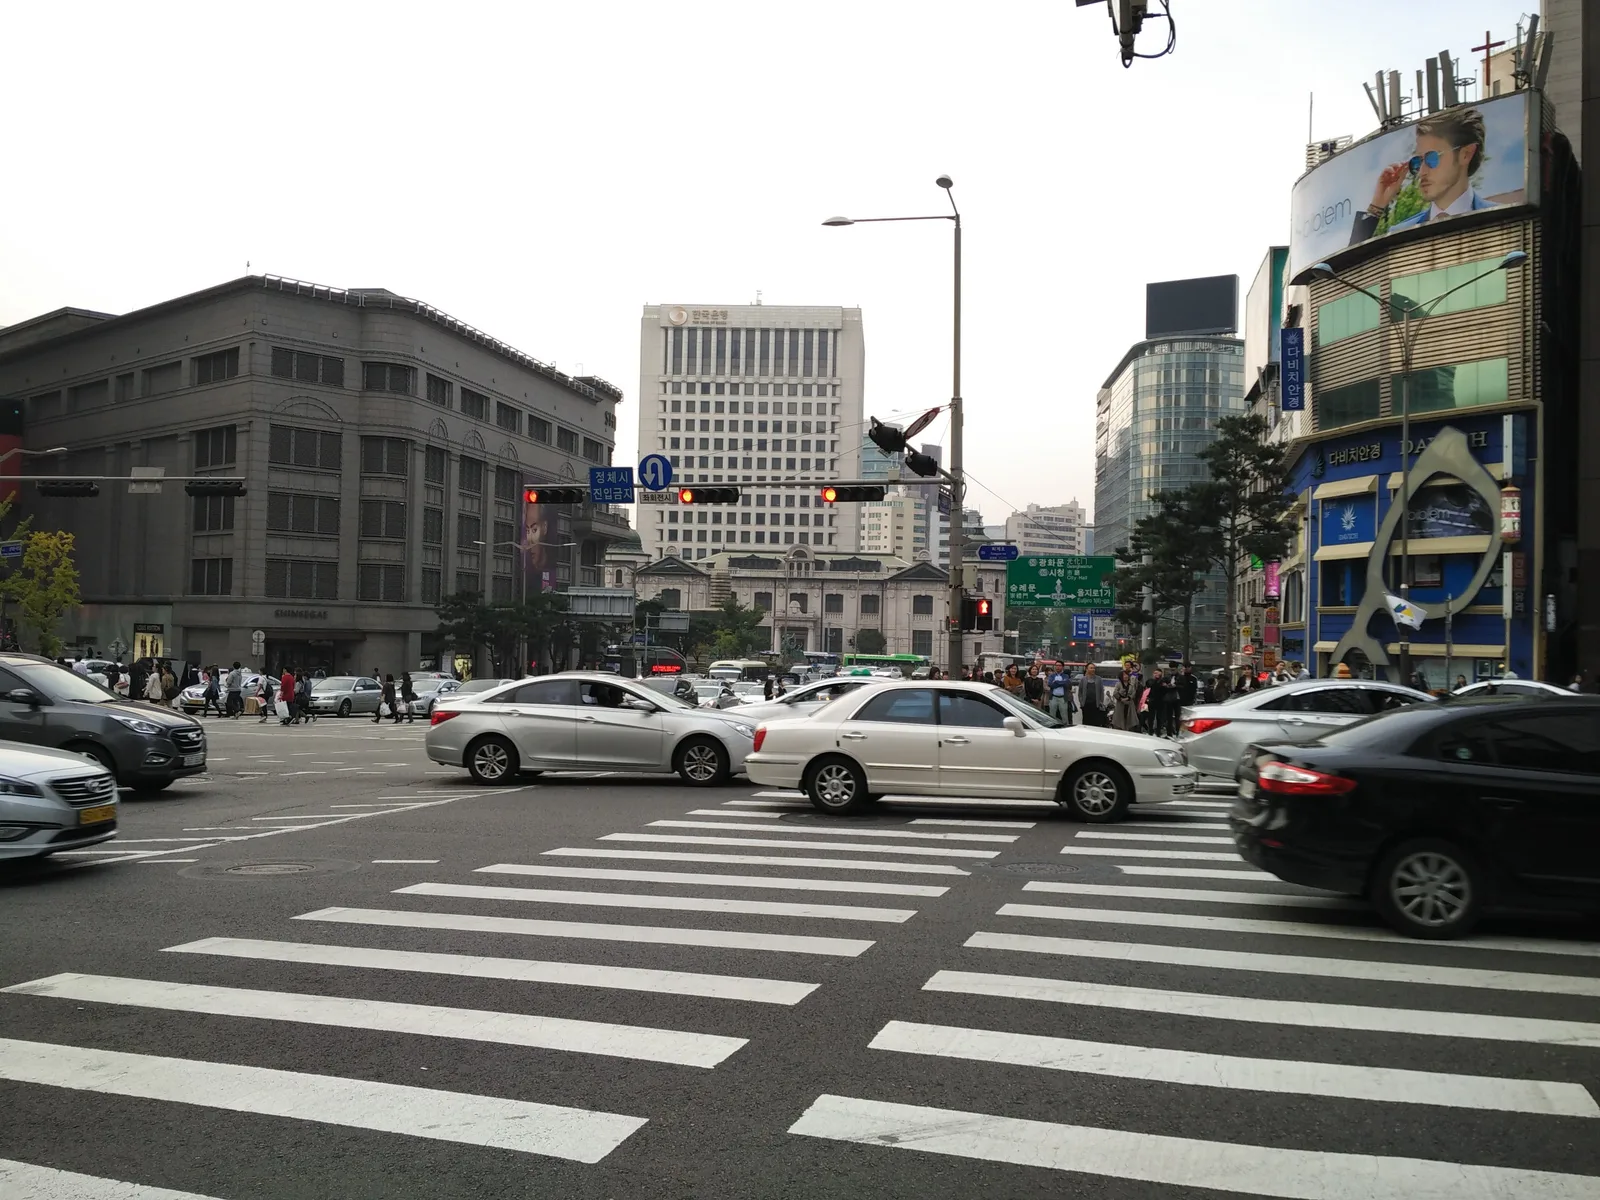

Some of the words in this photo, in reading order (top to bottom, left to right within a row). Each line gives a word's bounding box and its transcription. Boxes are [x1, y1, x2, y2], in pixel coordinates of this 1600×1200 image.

[691, 309, 728, 320] 한국은행
[1287, 346, 1301, 408] 다비치안경
[1328, 442, 1381, 466] 다비치안경
[595, 470, 628, 484] 정체시
[593, 487, 633, 500] 진입금지
[1038, 558, 1064, 567] 광화문
[1048, 568, 1064, 577] 시청
[1009, 584, 1036, 593] 숭례문
[1077, 588, 1111, 597] 을지로1가
